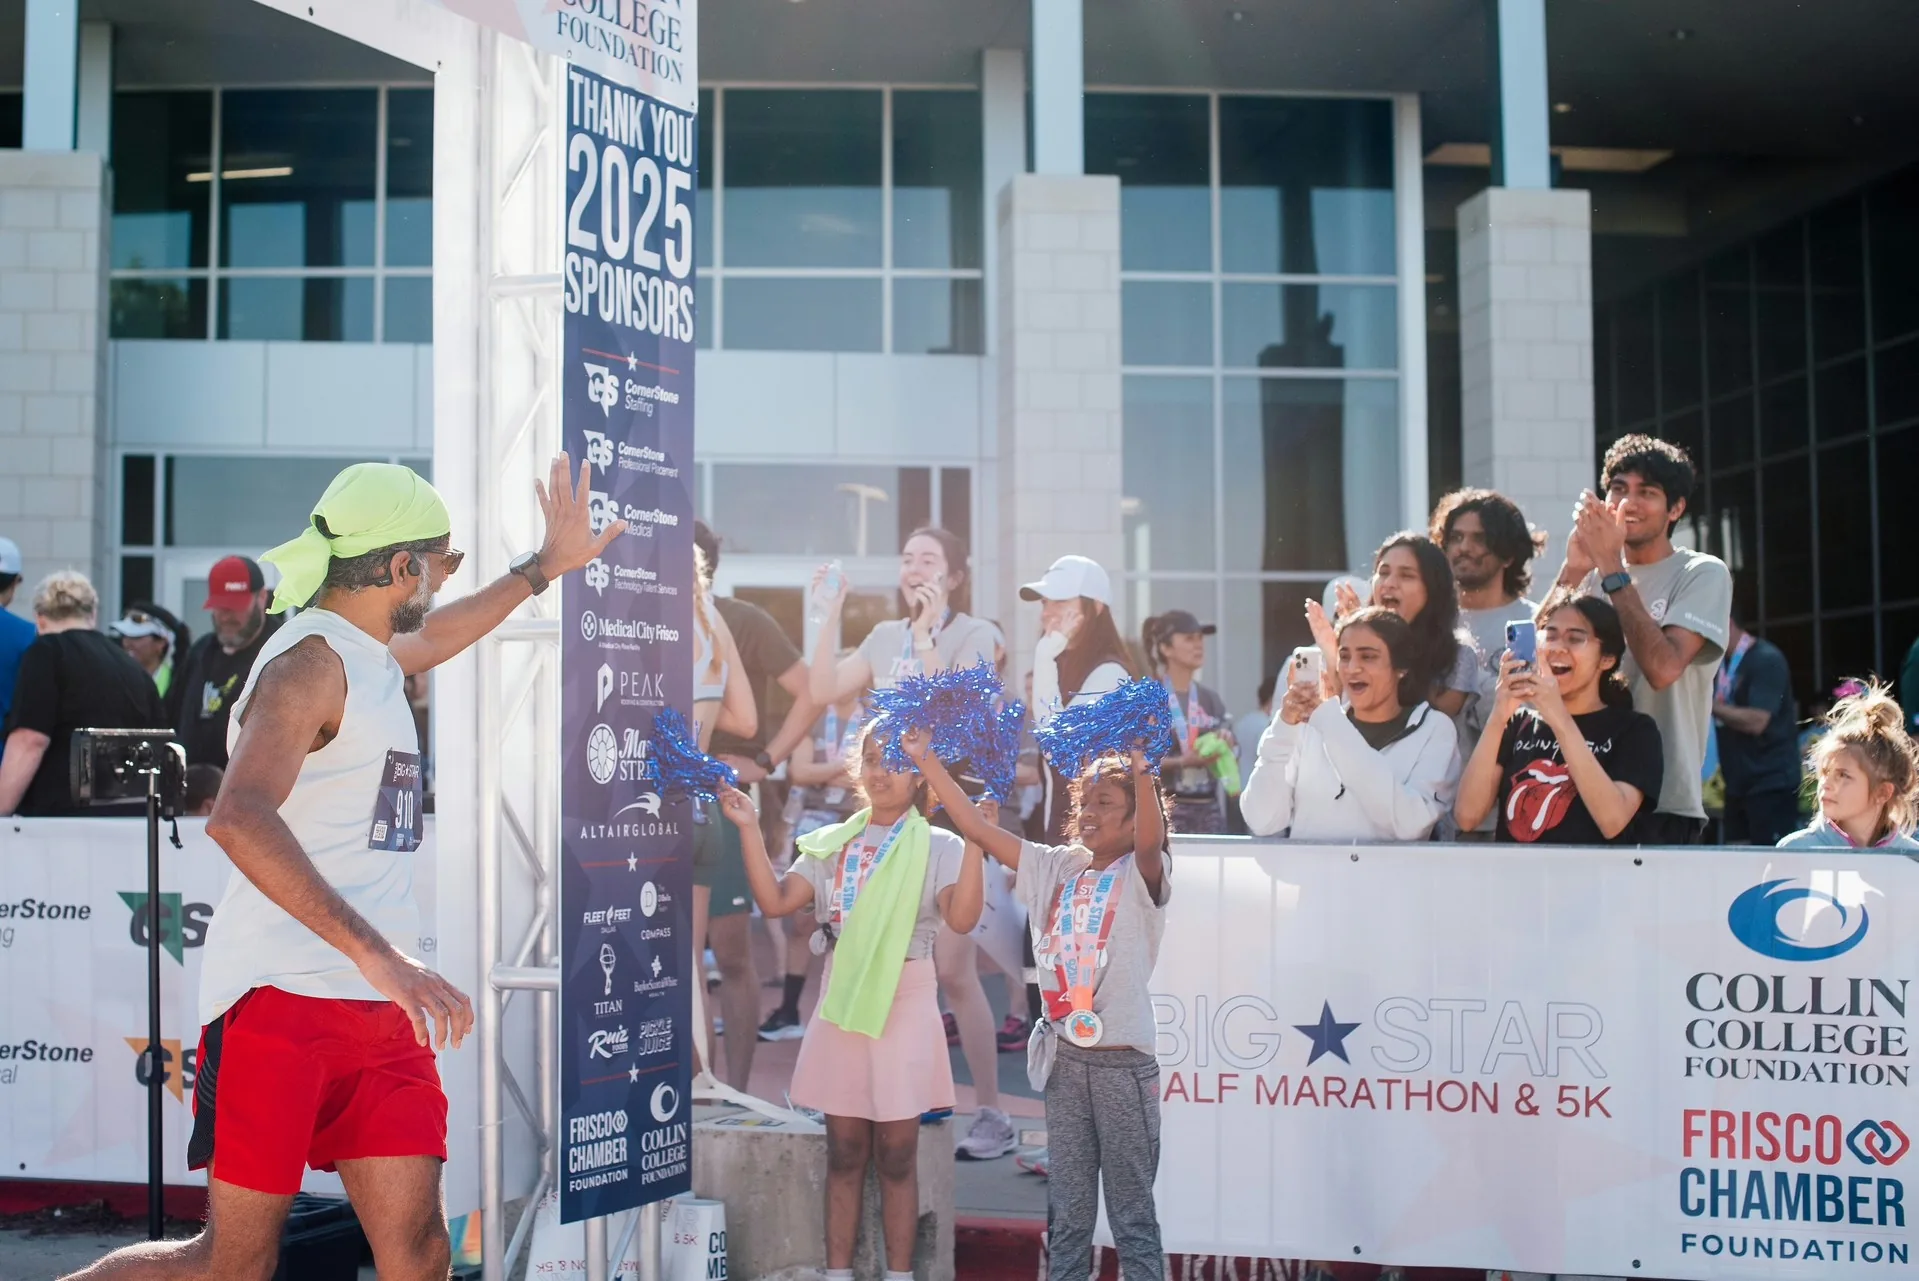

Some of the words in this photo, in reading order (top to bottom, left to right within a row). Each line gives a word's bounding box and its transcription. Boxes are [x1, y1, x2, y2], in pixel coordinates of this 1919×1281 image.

[563, 0, 682, 52] LLEGE
[557, 10, 682, 84] FOUNDATION
[568, 70, 645, 151] THANK
[650, 103, 693, 167] YOU
[568, 132, 692, 279] 2025
[565, 252, 693, 343] SPONSORS
[625, 379, 679, 404] CornerStone
[625, 395, 653, 417] Staffing
[618, 442, 665, 462] CornerStone
[618, 457, 651, 473] Professional
[651, 463, 678, 478] Placement
[624, 504, 678, 526] CornerStone
[625, 521, 654, 537] Medical
[614, 565, 657, 580] CornerStone
[658, 584, 678, 596] Services
[599, 619, 636, 638] Medical
[637, 621, 655, 644] City
[656, 625, 679, 641] Frisco
[620, 671, 664, 697] PEAK
[395, 790, 413, 829] 910
[580, 823, 679, 839] ALTAIRGLOBAL
[583, 911, 606, 924] FLEET
[614, 908, 632, 921] FEET
[641, 927, 671, 940] COMPASS
[594, 1000, 623, 1015] TITAN
[1685, 972, 1910, 1018] COLLIN
[588, 1025, 629, 1059] Ruiz
[1150, 994, 1281, 1069] BIG
[1371, 996, 1607, 1079] STAR
[1685, 1018, 1909, 1057] COLLEGE
[1684, 1056, 1910, 1087] FOUNDATION
[1256, 1074, 1499, 1114] MARATHON
[1514, 1083, 1540, 1116] &
[1556, 1085, 1612, 1119] 5K
[569, 1111, 613, 1144] FRISCO
[641, 1122, 687, 1152] COLLIN
[1683, 1109, 1842, 1166] FRISCO
[569, 1137, 628, 1174] CHAMBER
[641, 1145, 687, 1171] COLLEGE
[569, 1169, 628, 1192] FOUNDATION
[641, 1161, 687, 1185] FOUNDATION
[1679, 1167, 1905, 1228] CHAMBER
[682, 1233, 698, 1246] 5K
[1681, 1233, 1908, 1264] FOUNDATION
